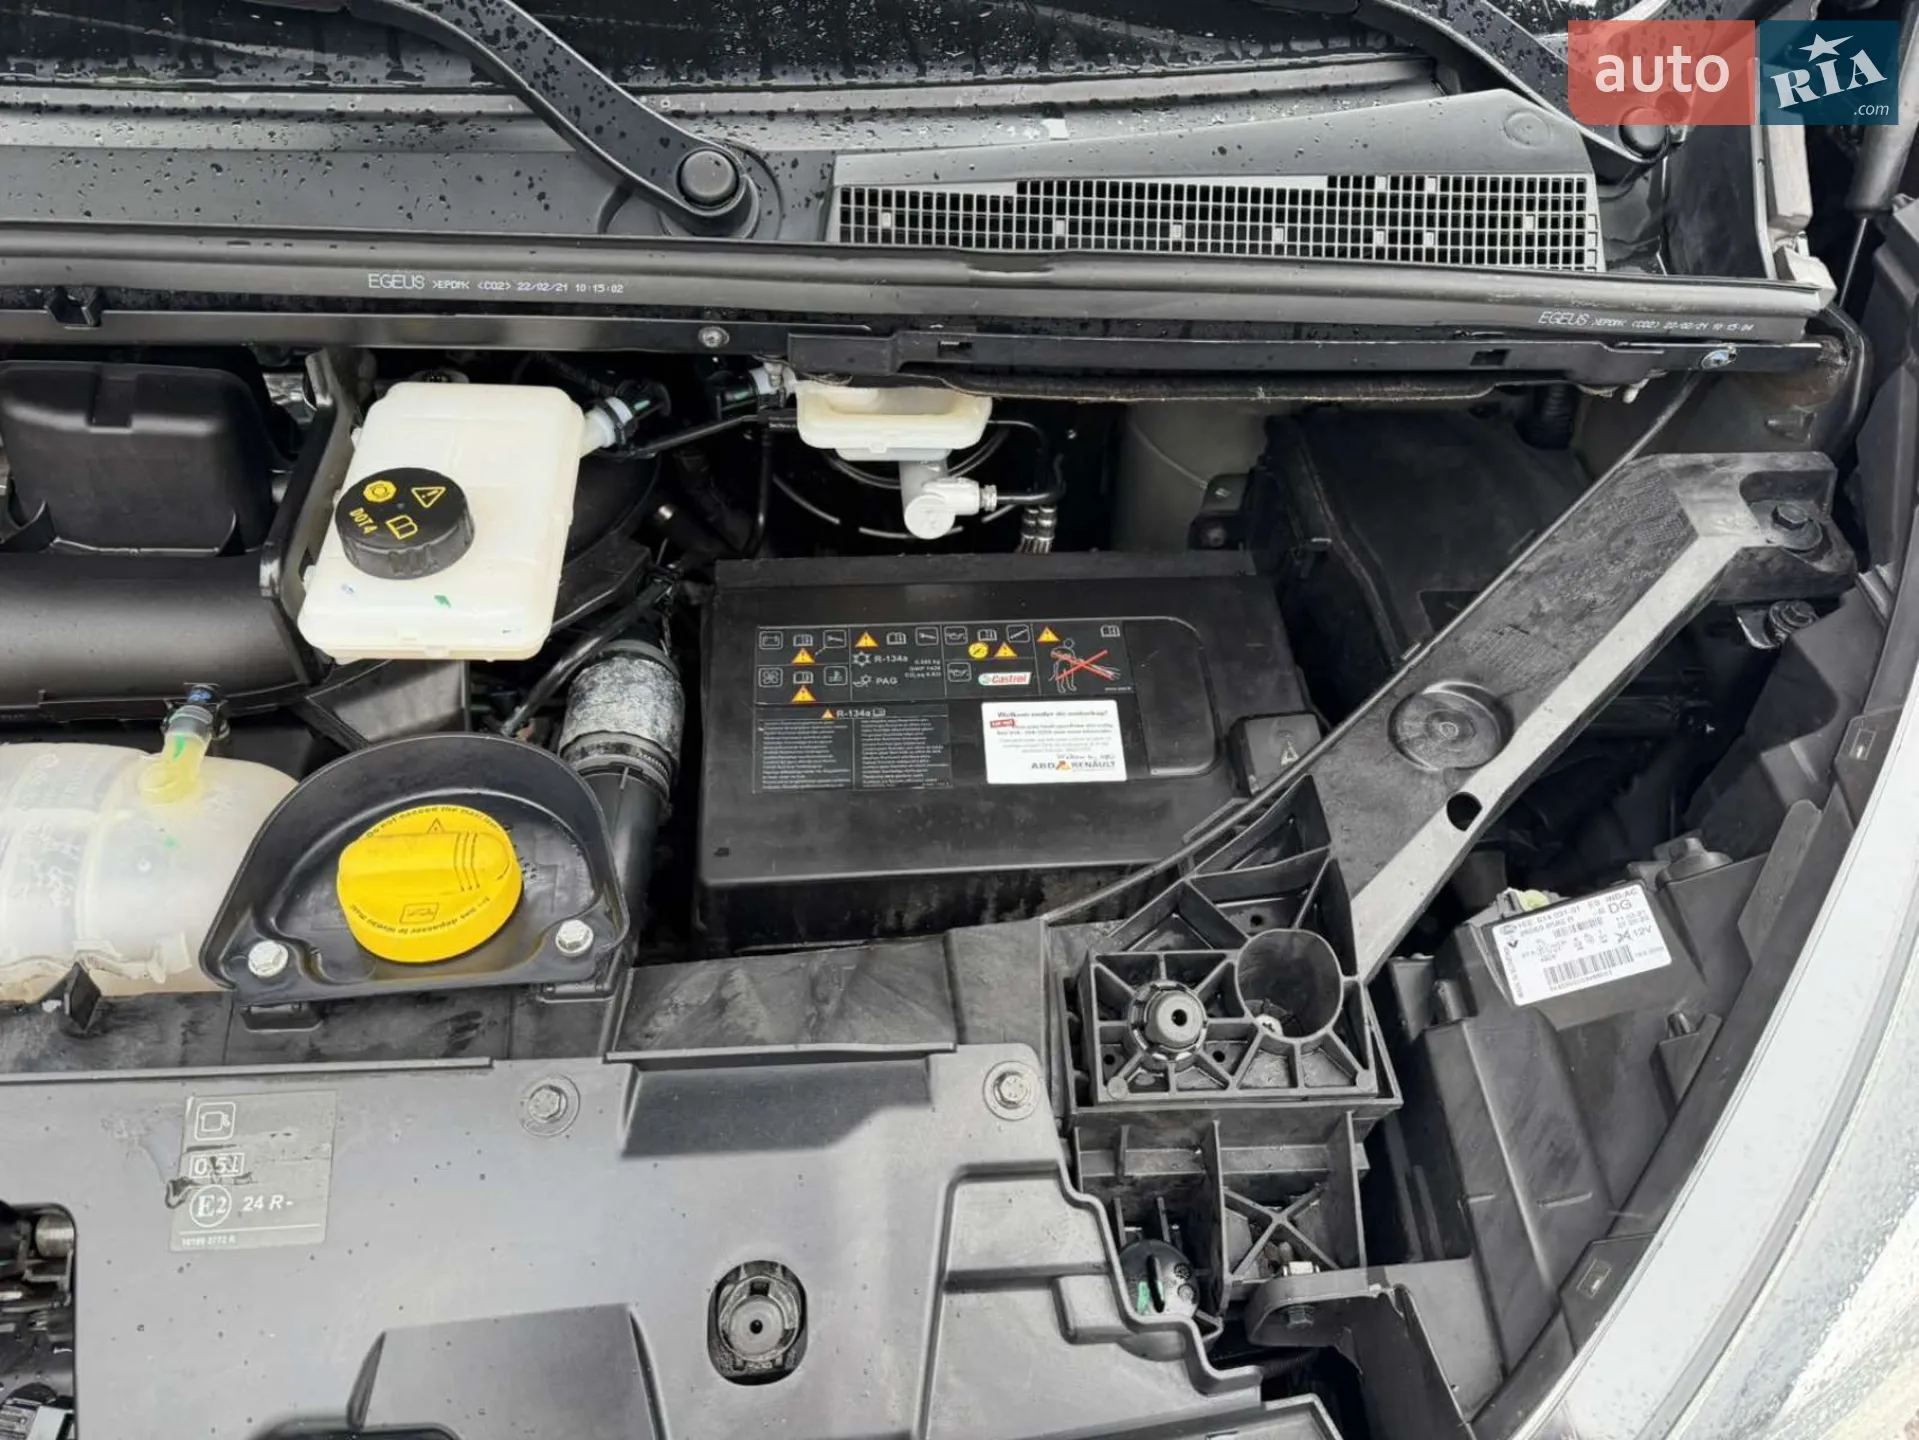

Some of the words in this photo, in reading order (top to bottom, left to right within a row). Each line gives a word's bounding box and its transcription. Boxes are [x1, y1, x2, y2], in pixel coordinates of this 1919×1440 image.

[368, 273, 425, 290] EGEUS
[1538, 311, 1589, 326] EGEUS
[349, 507, 378, 534] DOT4
[876, 677, 898, 685] PAG
[991, 674, 1027, 684] Castrol
[1609, 900, 1632, 914] DG
[242, 1195, 264, 1212] 24
